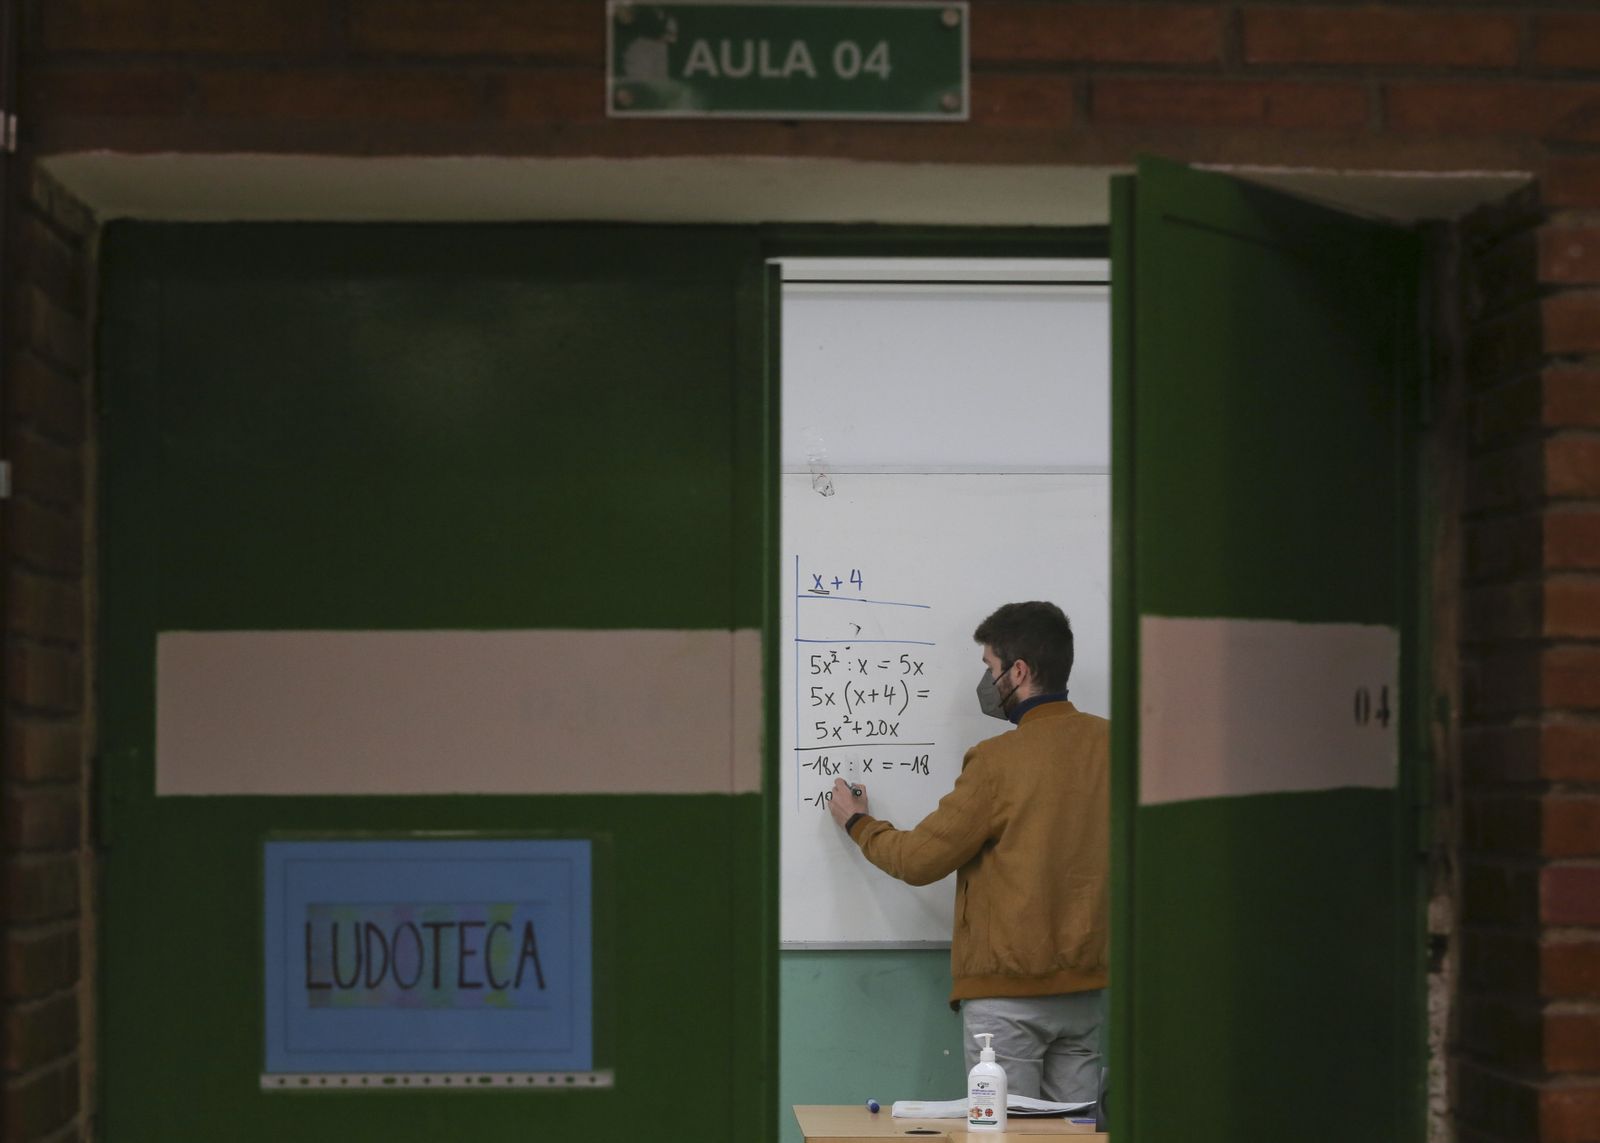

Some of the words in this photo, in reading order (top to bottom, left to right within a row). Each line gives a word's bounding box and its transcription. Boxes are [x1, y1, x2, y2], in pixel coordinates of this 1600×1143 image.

[684, 39, 817, 78] AULA
[832, 40, 893, 79] 04
[1354, 685, 1391, 728] 04
[305, 920, 546, 991] LUDOTECA
